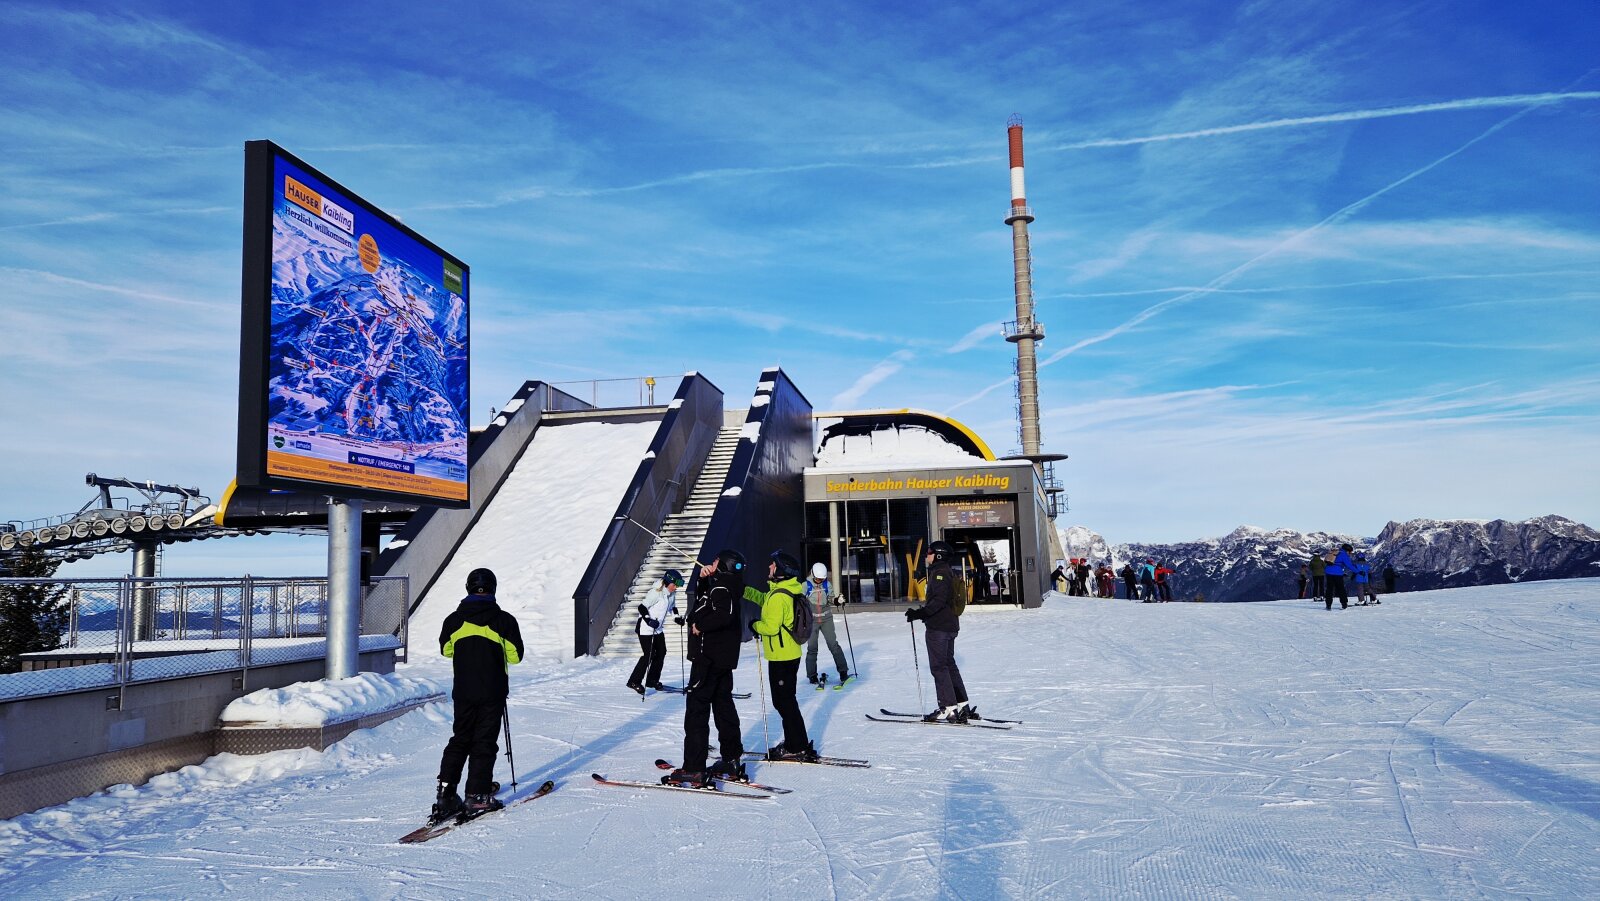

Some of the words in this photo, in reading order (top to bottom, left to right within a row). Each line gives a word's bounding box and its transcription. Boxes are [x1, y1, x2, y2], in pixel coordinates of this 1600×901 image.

[285, 205, 313, 228] Herzlich
[288, 183, 319, 210] HAUSER
[323, 203, 352, 231] Kaibling
[826, 478, 903, 492] Senderbahn
[906, 478, 952, 489] Hauser
[954, 474, 1009, 489] Kaibling
